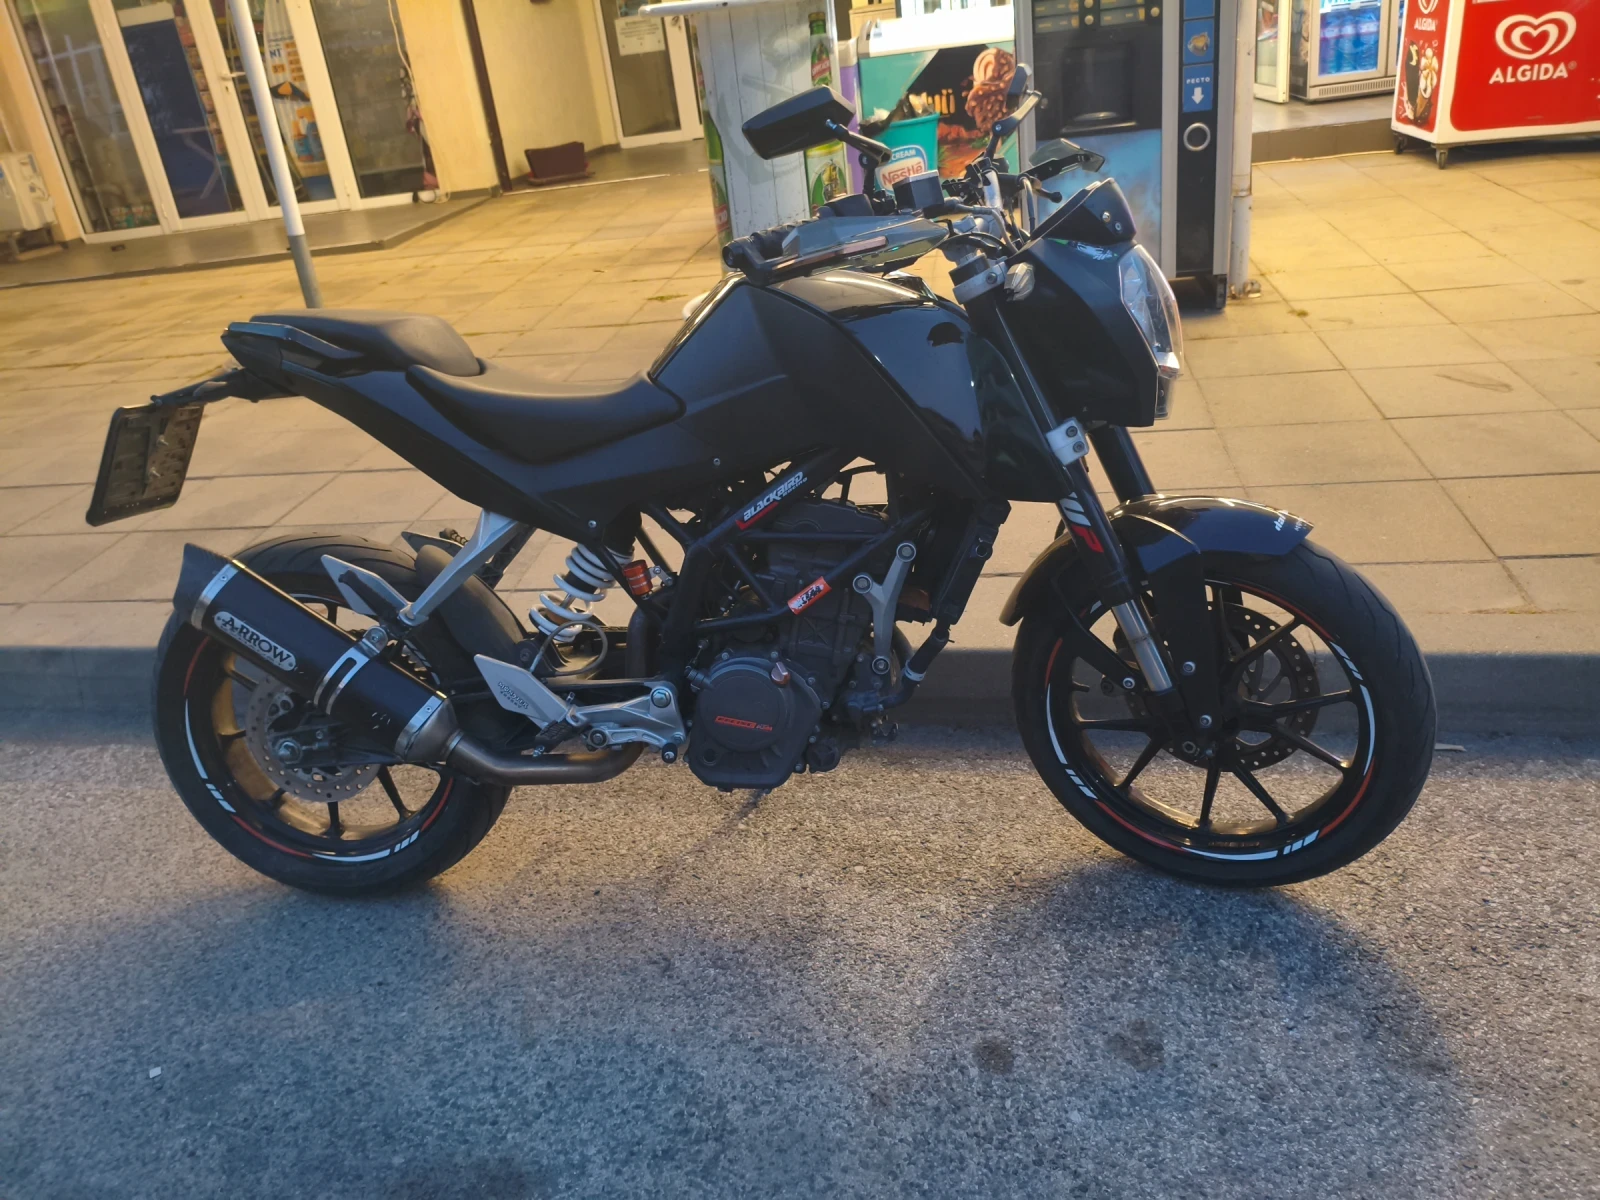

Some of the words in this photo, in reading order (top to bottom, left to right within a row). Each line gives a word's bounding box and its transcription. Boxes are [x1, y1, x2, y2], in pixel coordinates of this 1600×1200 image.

[1414, 17, 1437, 32] ALGIDA
[1488, 62, 1569, 85] ALGIDA
[881, 161, 923, 186] Nestlé
[221, 616, 292, 663] ARROW
